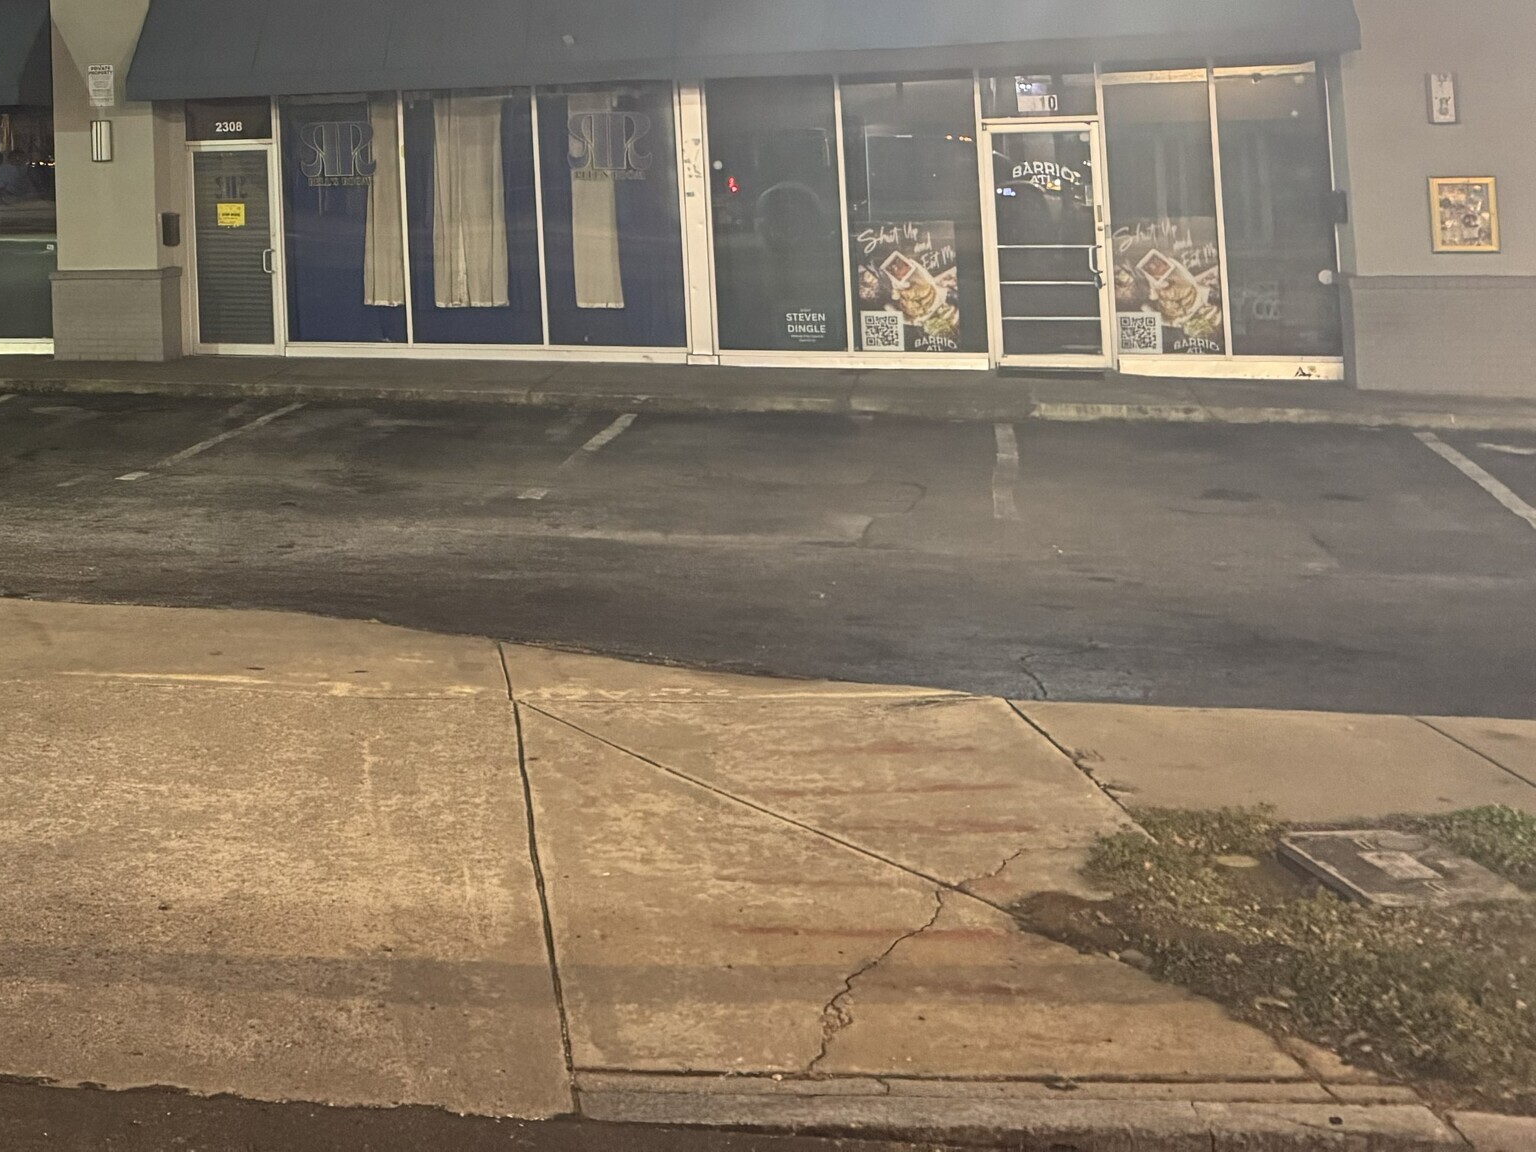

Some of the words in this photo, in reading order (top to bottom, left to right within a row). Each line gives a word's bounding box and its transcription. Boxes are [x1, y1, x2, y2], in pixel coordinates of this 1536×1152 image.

[215, 121, 243, 132] 2308
[1013, 161, 1075, 181] BARRIO
[857, 226, 902, 254] Shut
[903, 222, 918, 241] Up
[921, 251, 940, 270] Eat
[785, 313, 826, 322] STEVEN
[787, 324, 826, 333] DINGLE
[914, 335, 958, 350] BARRIO
[1174, 336, 1220, 352] BARRIO
